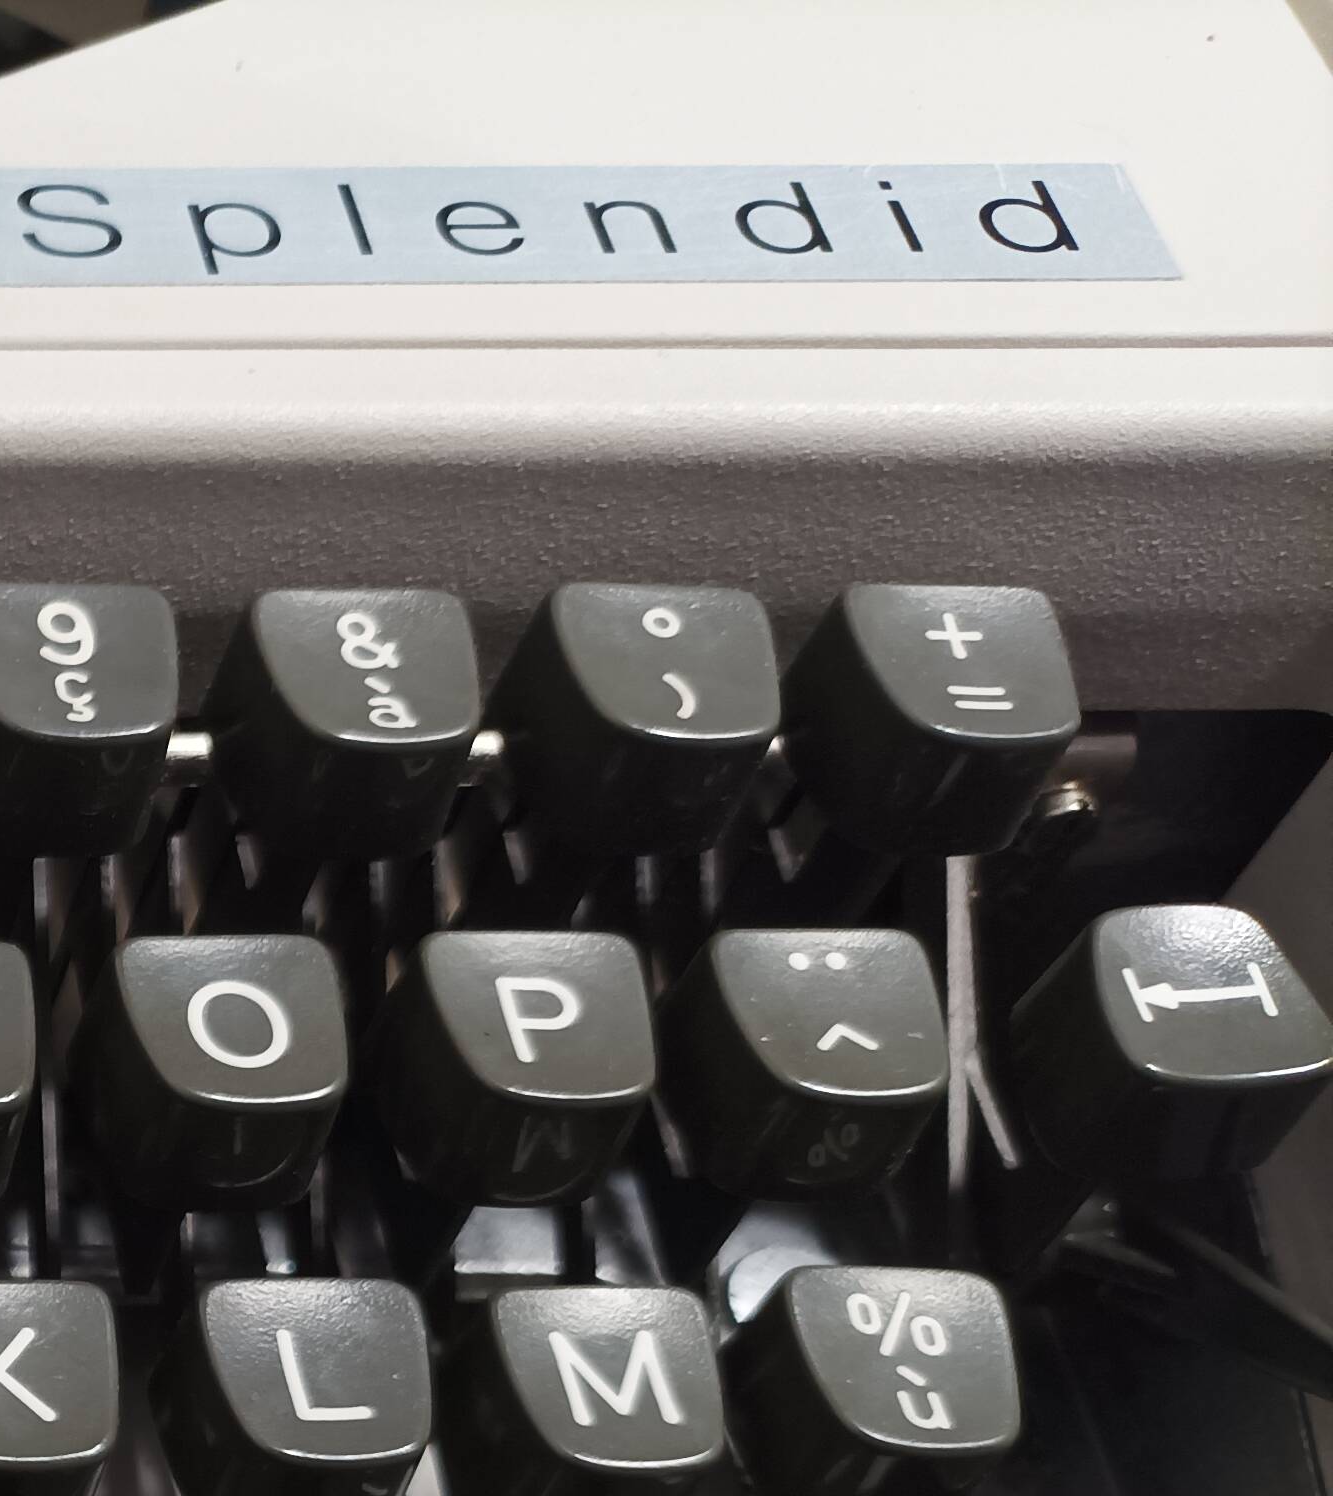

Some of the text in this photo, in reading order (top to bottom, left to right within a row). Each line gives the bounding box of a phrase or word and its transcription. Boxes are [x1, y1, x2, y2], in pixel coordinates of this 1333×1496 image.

[17, 180, 1079, 274] Splendid
[36, 600, 96, 666] 9
[336, 609, 401, 671] &
[925, 613, 983, 659] +
[187, 979, 290, 1069] O
[494, 975, 582, 1063] P
[846, 1290, 949, 1358] %
[276, 1325, 374, 1421] L
[547, 1329, 683, 1426] M
